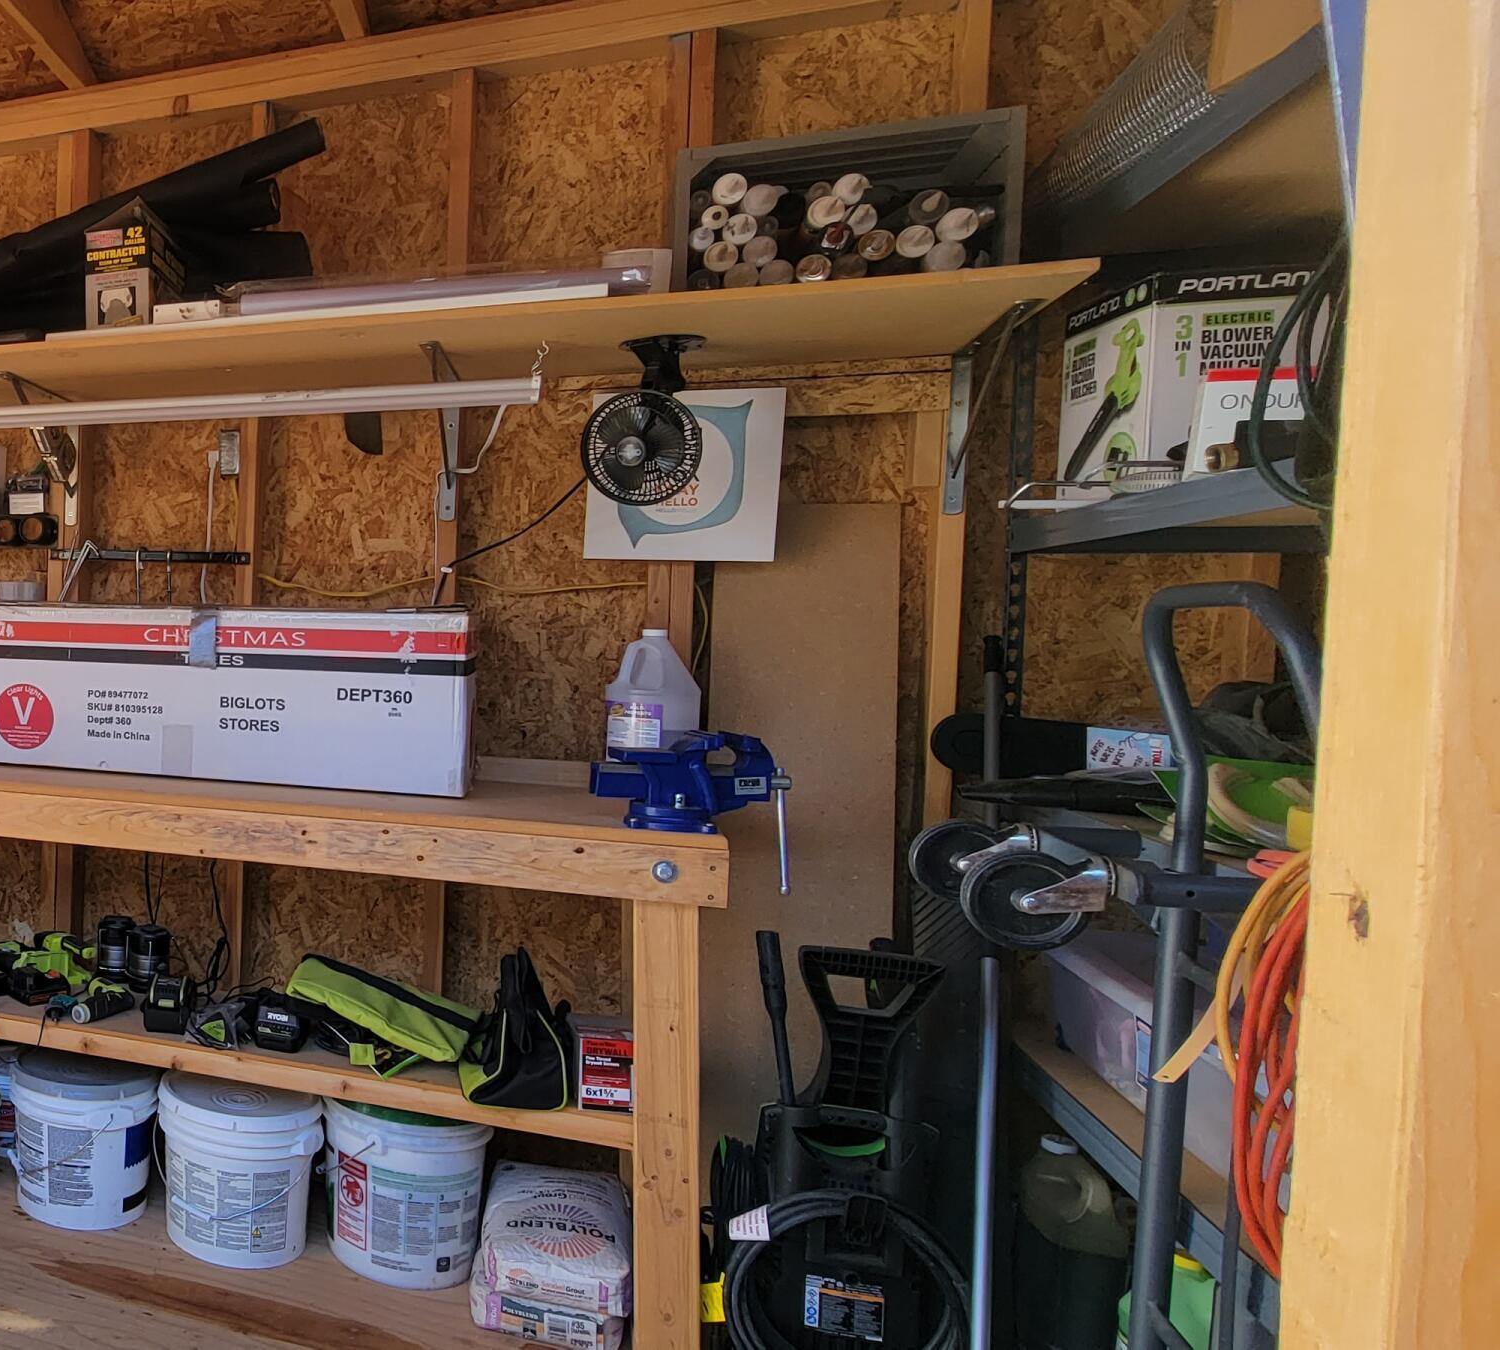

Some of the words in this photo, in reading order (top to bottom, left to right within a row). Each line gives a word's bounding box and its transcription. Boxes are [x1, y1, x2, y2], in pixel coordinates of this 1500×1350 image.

[126, 226, 143, 239] 42
[86, 245, 146, 262] CONTRACTOR
[1178, 270, 1315, 295] PORTLAN
[1068, 295, 1121, 331] PORTLAND
[1205, 311, 1273, 325] ELECTRIC
[1176, 315, 1194, 340] 3
[1201, 326, 1274, 344] BLOWER
[1175, 341, 1191, 352] IN
[1072, 352, 1096, 373] BLOWER
[1175, 352, 1188, 378] 1
[1199, 359, 1261, 376] MULCH
[1071, 366, 1096, 387] VACUUM
[1070, 381, 1097, 401] MULCHER
[143, 627, 307, 647] CHSTMAS
[181, 653, 245, 666] TES
[7, 685, 24, 697] Clear
[24, 685, 44, 701] Lights
[87, 689, 107, 698] PO#
[107, 690, 149, 700] 89477072
[336, 687, 413, 705] DEPT360
[11, 696, 36, 725] V
[87, 702, 113, 712] SKU#
[114, 703, 164, 715] 810395128
[219, 696, 286, 711] BIGLOTS
[87, 715, 114, 725] Dept#
[115, 716, 132, 726] 360
[218, 717, 280, 732] STORES
[87, 729, 112, 739] Made
[123, 731, 151, 741] China
[267, 1012, 289, 1022] RYOBI
[586, 1046, 628, 1057] DRYWALL
[506, 1219, 616, 1243] POLYBLEND
[505, 1274, 539, 1289] POLYBLEND
[565, 1285, 585, 1296] Grout
[502, 1305, 539, 1320] POLYBLEND
